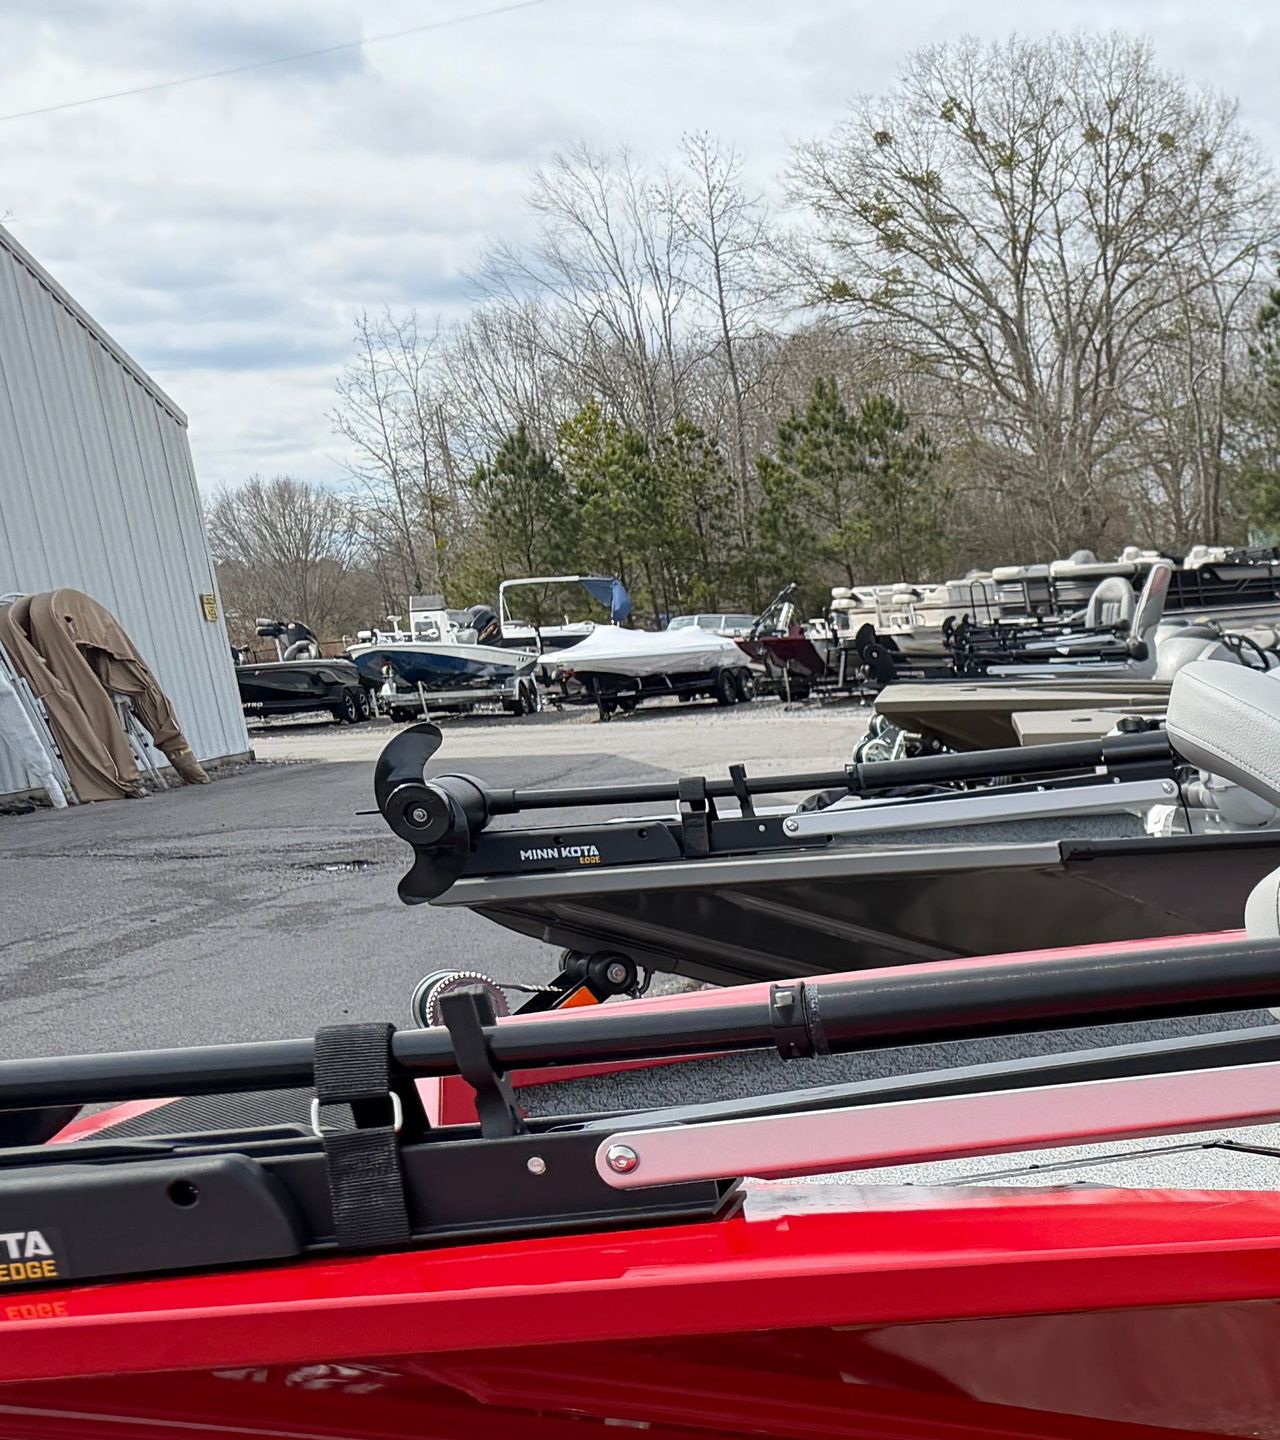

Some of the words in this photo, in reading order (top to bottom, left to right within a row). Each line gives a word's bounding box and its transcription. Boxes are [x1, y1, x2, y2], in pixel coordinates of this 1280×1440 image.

[520, 848, 559, 861] MINN
[561, 845, 599, 858] KOTA
[0, 1259, 59, 1282] EDGE
